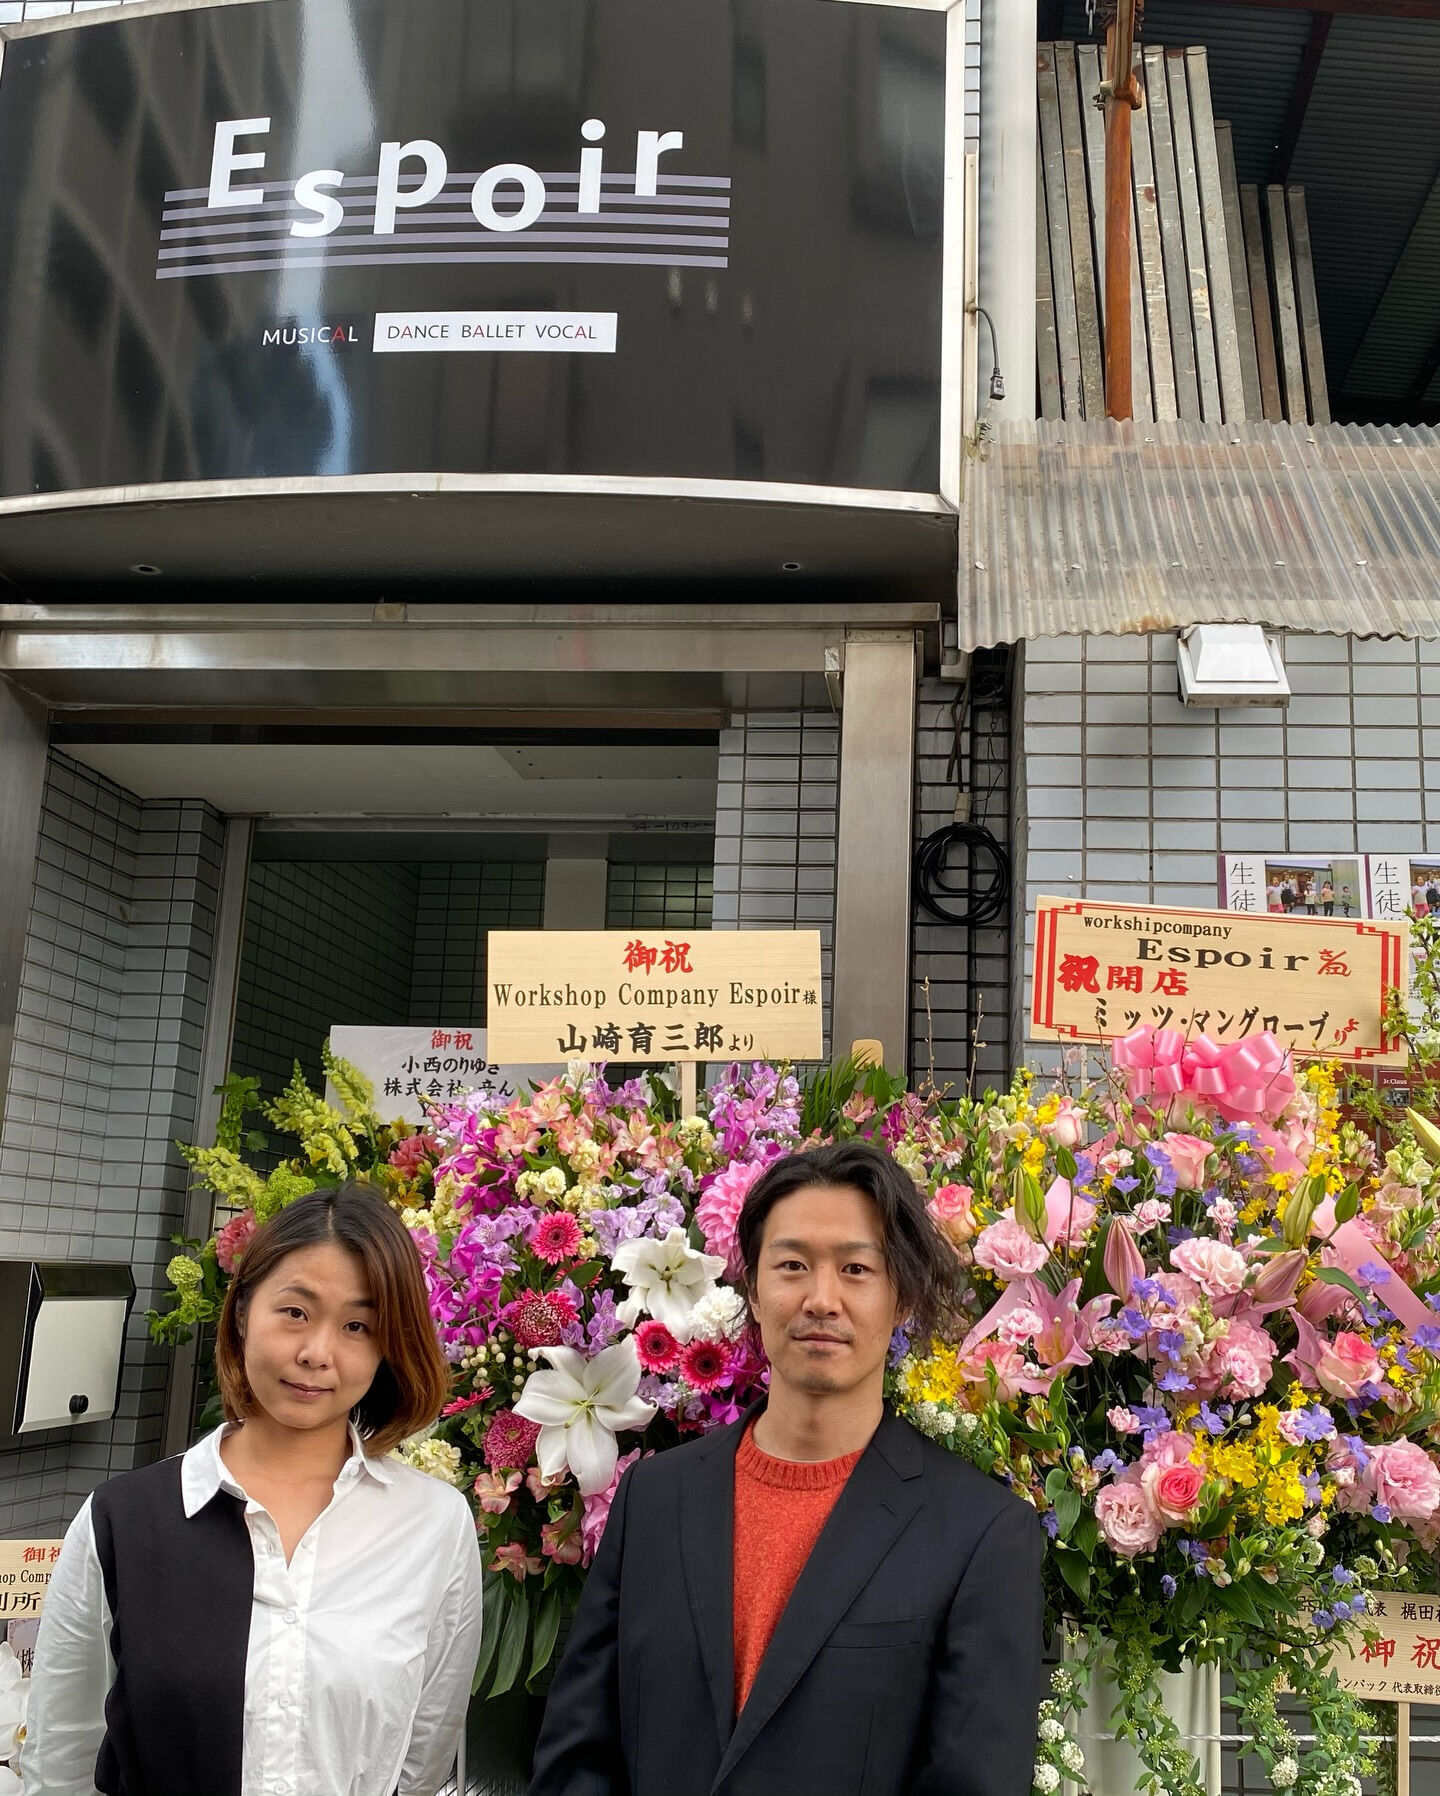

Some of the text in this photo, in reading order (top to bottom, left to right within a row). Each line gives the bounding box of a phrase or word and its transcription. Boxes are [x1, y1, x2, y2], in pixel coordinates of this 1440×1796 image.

[207, 117, 684, 238] Espoir
[261, 324, 597, 346] MUSICAL DANCE BALLET VOCAL
[1374, 861, 1401, 920] 生徒
[1083, 914, 1232, 939] workshipcompany
[622, 939, 694, 976] 御祝
[1136, 938, 1310, 971] Espoir
[493, 983, 607, 1008] Workshop
[618, 982, 719, 1008] Company
[430, 1029, 474, 1051] 御祝
